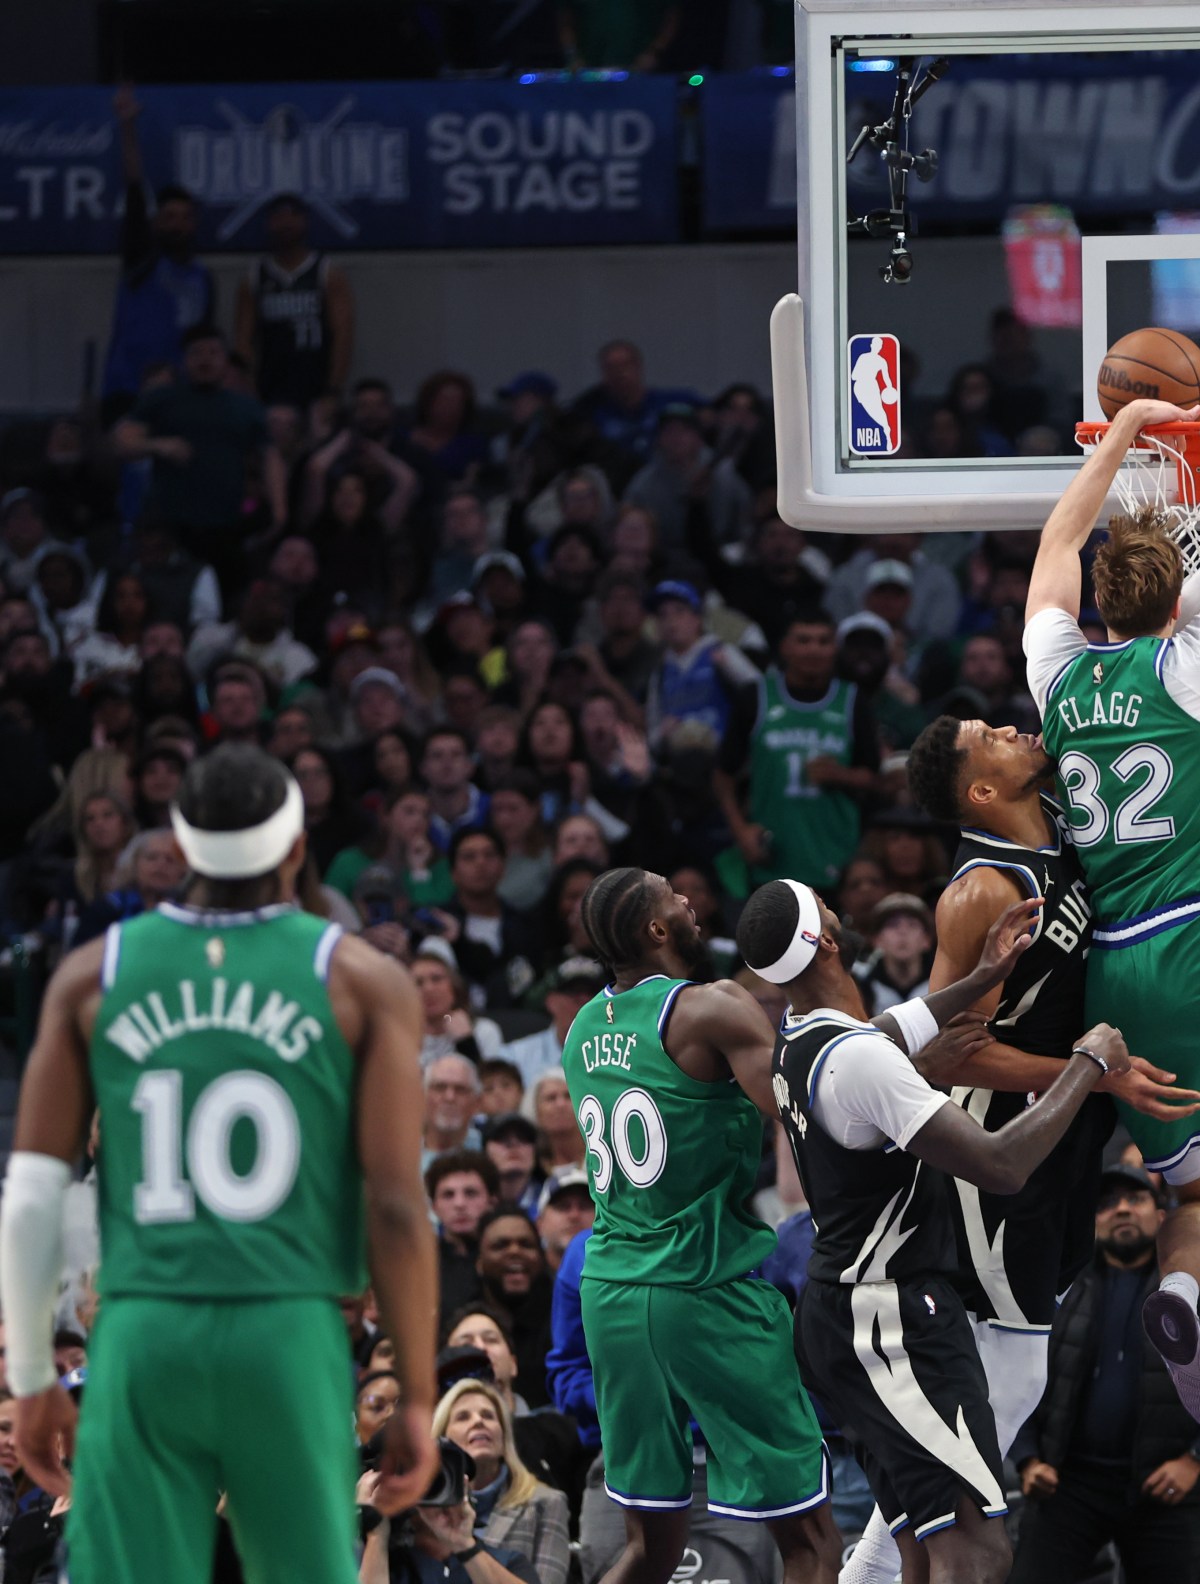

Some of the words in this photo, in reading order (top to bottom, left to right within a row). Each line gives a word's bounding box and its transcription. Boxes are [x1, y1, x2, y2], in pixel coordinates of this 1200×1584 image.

[427, 110, 654, 162] SOUND
[443, 160, 642, 216] STAGE
[1100, 363, 1160, 400] Wilson
[857, 427, 881, 447] NBA
[1058, 691, 1143, 733] FLAGG
[1058, 742, 1176, 847] 32
[106, 976, 323, 1063] WILLIAMS
[581, 1033, 637, 1073] CISSÉ
[130, 1068, 302, 1225] 10
[578, 1087, 668, 1194] 30
